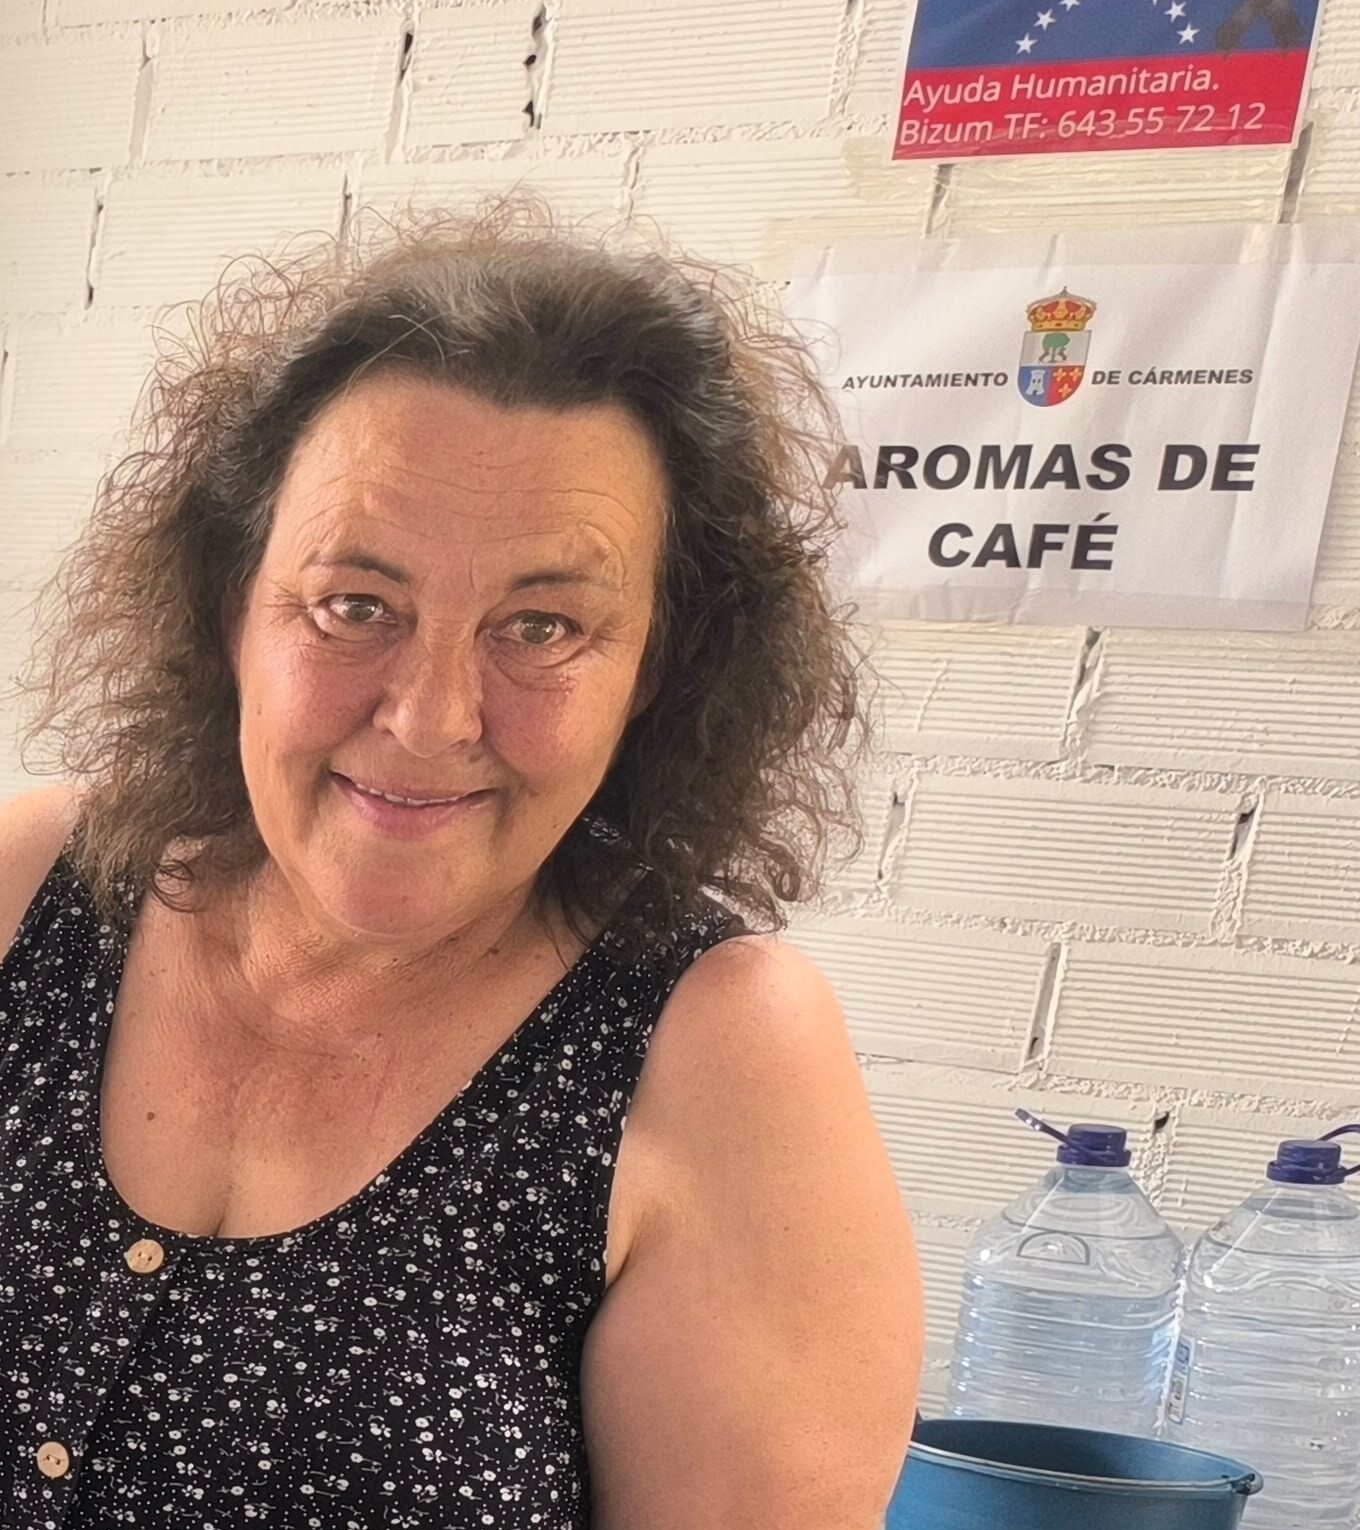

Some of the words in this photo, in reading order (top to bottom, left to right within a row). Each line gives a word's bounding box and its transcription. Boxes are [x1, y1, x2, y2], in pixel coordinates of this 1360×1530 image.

[904, 75, 1000, 112] Ayuda
[1010, 64, 1220, 101] Humanitaria.
[900, 119, 994, 146] Bizum
[1003, 112, 1049, 141] TF:
[1057, 109, 1115, 138] 643
[1116, 106, 1164, 135] 55
[1176, 104, 1214, 133] 72
[1228, 101, 1266, 131] 12
[842, 371, 1009, 391] AYUNTAMIENTO
[1091, 369, 1121, 386] DE
[1128, 365, 1254, 386] CÁRMENES
[823, 443, 1133, 491] AROMAS
[1157, 443, 1261, 492] DE
[928, 511, 1120, 571] CAFÉ
